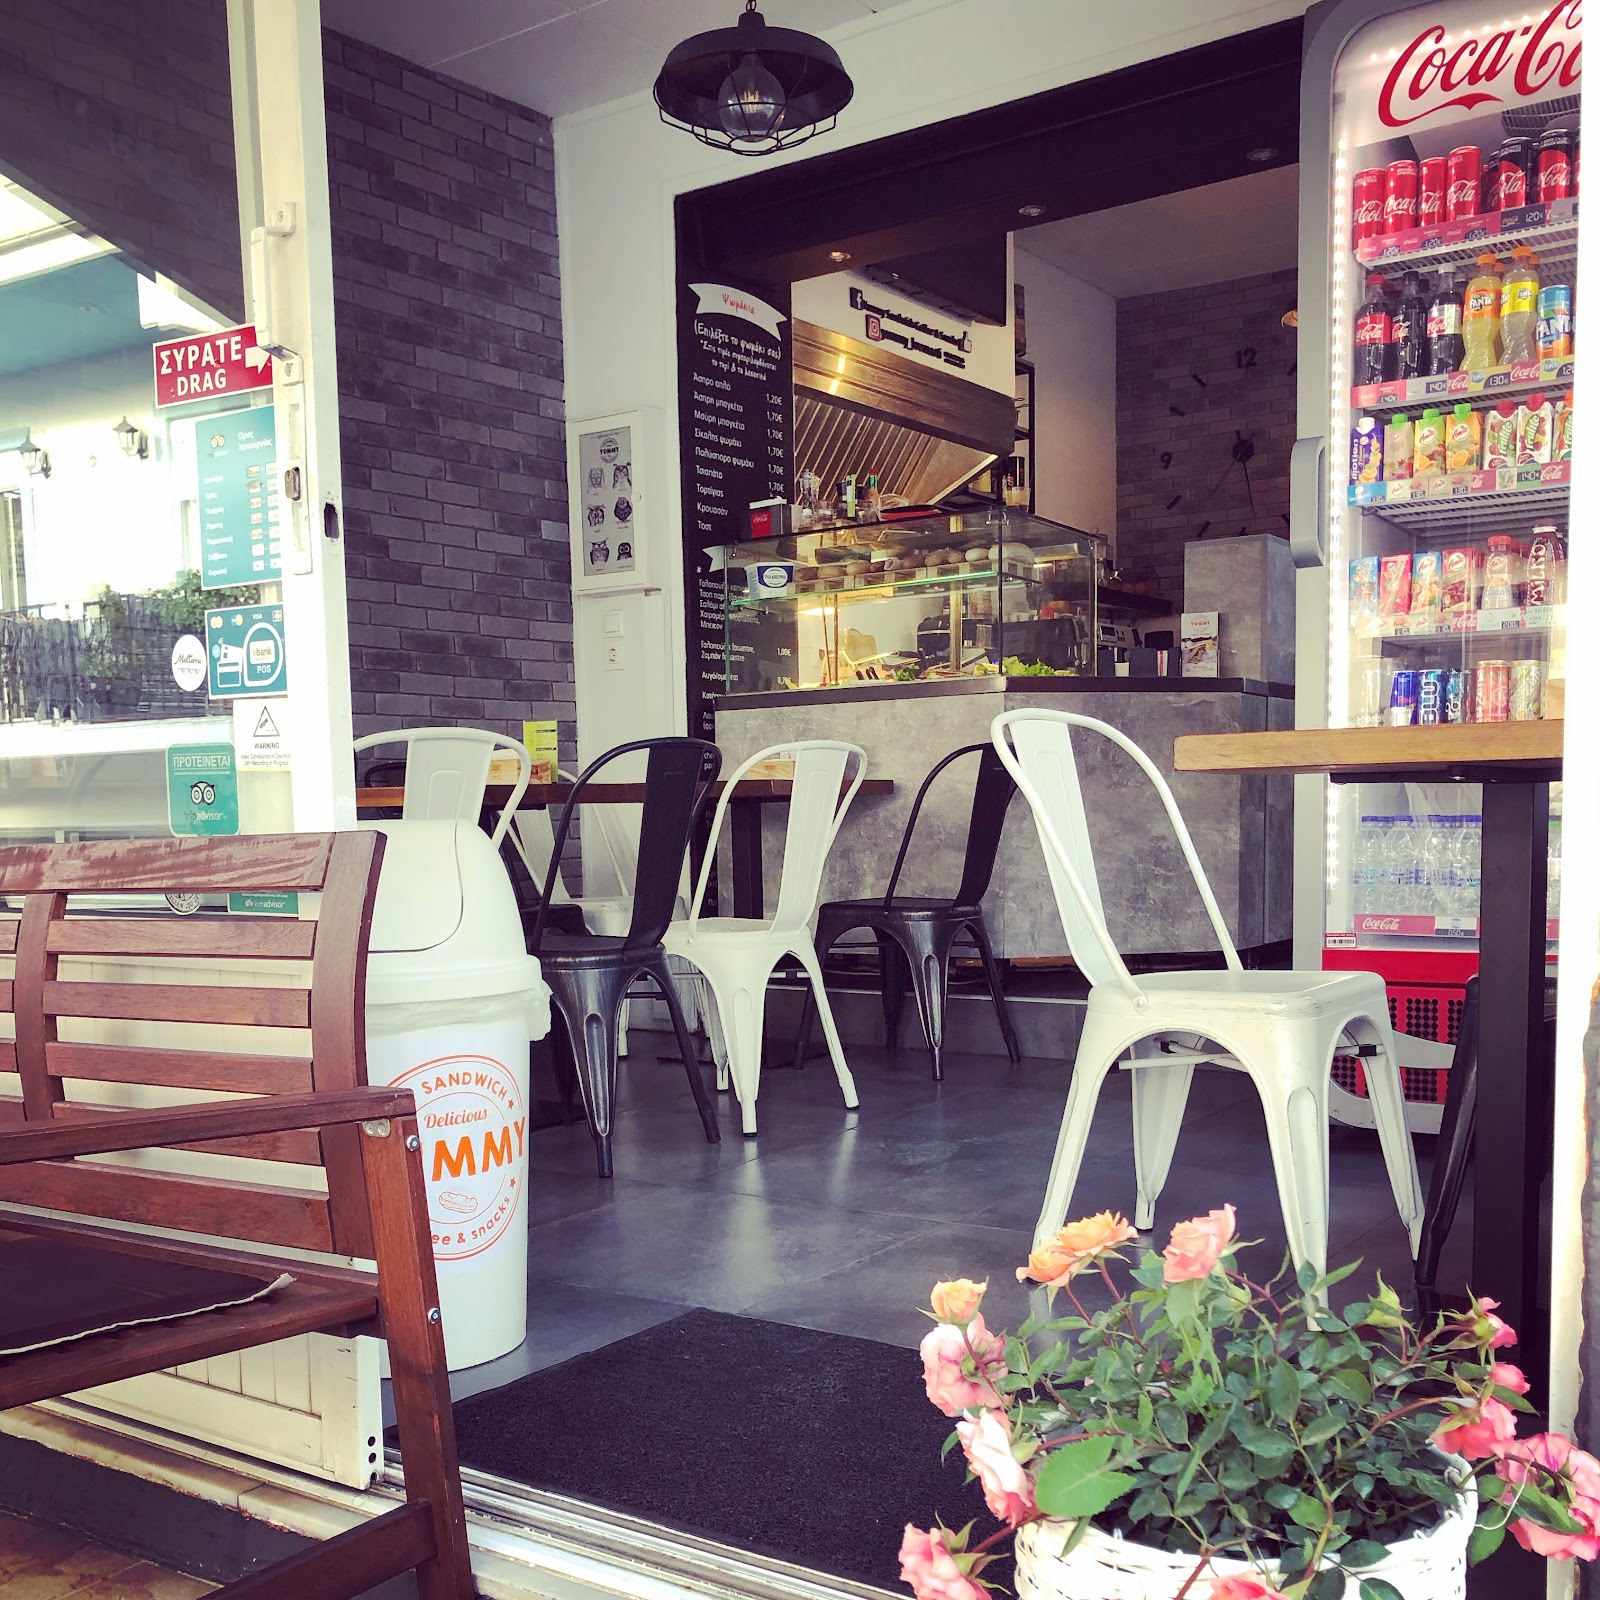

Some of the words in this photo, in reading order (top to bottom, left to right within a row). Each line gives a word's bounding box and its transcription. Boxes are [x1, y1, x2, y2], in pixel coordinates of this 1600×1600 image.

[722, 293, 755, 315] Ψωμάκια
[160, 336, 242, 375] ΣΥΡΑΤΕ
[731, 337, 738, 346] το
[740, 339, 765, 355] ψωμάκι
[730, 363, 737, 373] &
[177, 369, 227, 396] DRAG
[693, 372, 714, 386] Άσπρο
[714, 380, 731, 391] απλό
[766, 393, 783, 405] 1,20€
[693, 390, 715, 404] Άσπρη
[715, 398, 743, 412] μπαγκέτα
[766, 411, 783, 423] 1,70€
[694, 409, 717, 424] Μαύρη
[717, 417, 745, 430] μπαγκέτα
[767, 428, 783, 441] 1,70€
[599, 446, 619, 455] YUMMY
[694, 428, 719, 442] Σίκαλης
[719, 436, 742, 448] ψωμάκι
[767, 446, 784, 458] 1,70€
[695, 446, 731, 463] Πολύσπορο
[732, 458, 755, 469] ψωμάκι
[768, 463, 784, 476] 1,70€
[1351, 439, 1359, 480] motion
[768, 481, 785, 493] 1,70€
[697, 502, 728, 516] Κρουασάν
[697, 520, 712, 531] Τοστ
[1530, 544, 1546, 605] MILKO
[700, 599, 719, 610] Σαλάμι
[700, 610, 727, 622] Χοιρομέρ
[700, 620, 723, 630] Μπέικον
[701, 650, 721, 660] Ζαμπόν
[777, 648, 791, 657] 1,00€
[257, 665, 271, 674] POS
[174, 756, 230, 767] ΠΡΟΤΕΙΝΕΤΑΙ
[1362, 917, 1401, 930] Coca-Cola
[421, 1072, 508, 1101] SANDWICH
[424, 1109, 488, 1129] Delicious
[431, 1116, 526, 1182] MMY
[457, 1233, 466, 1244] &
[472, 1196, 510, 1240] snacks
